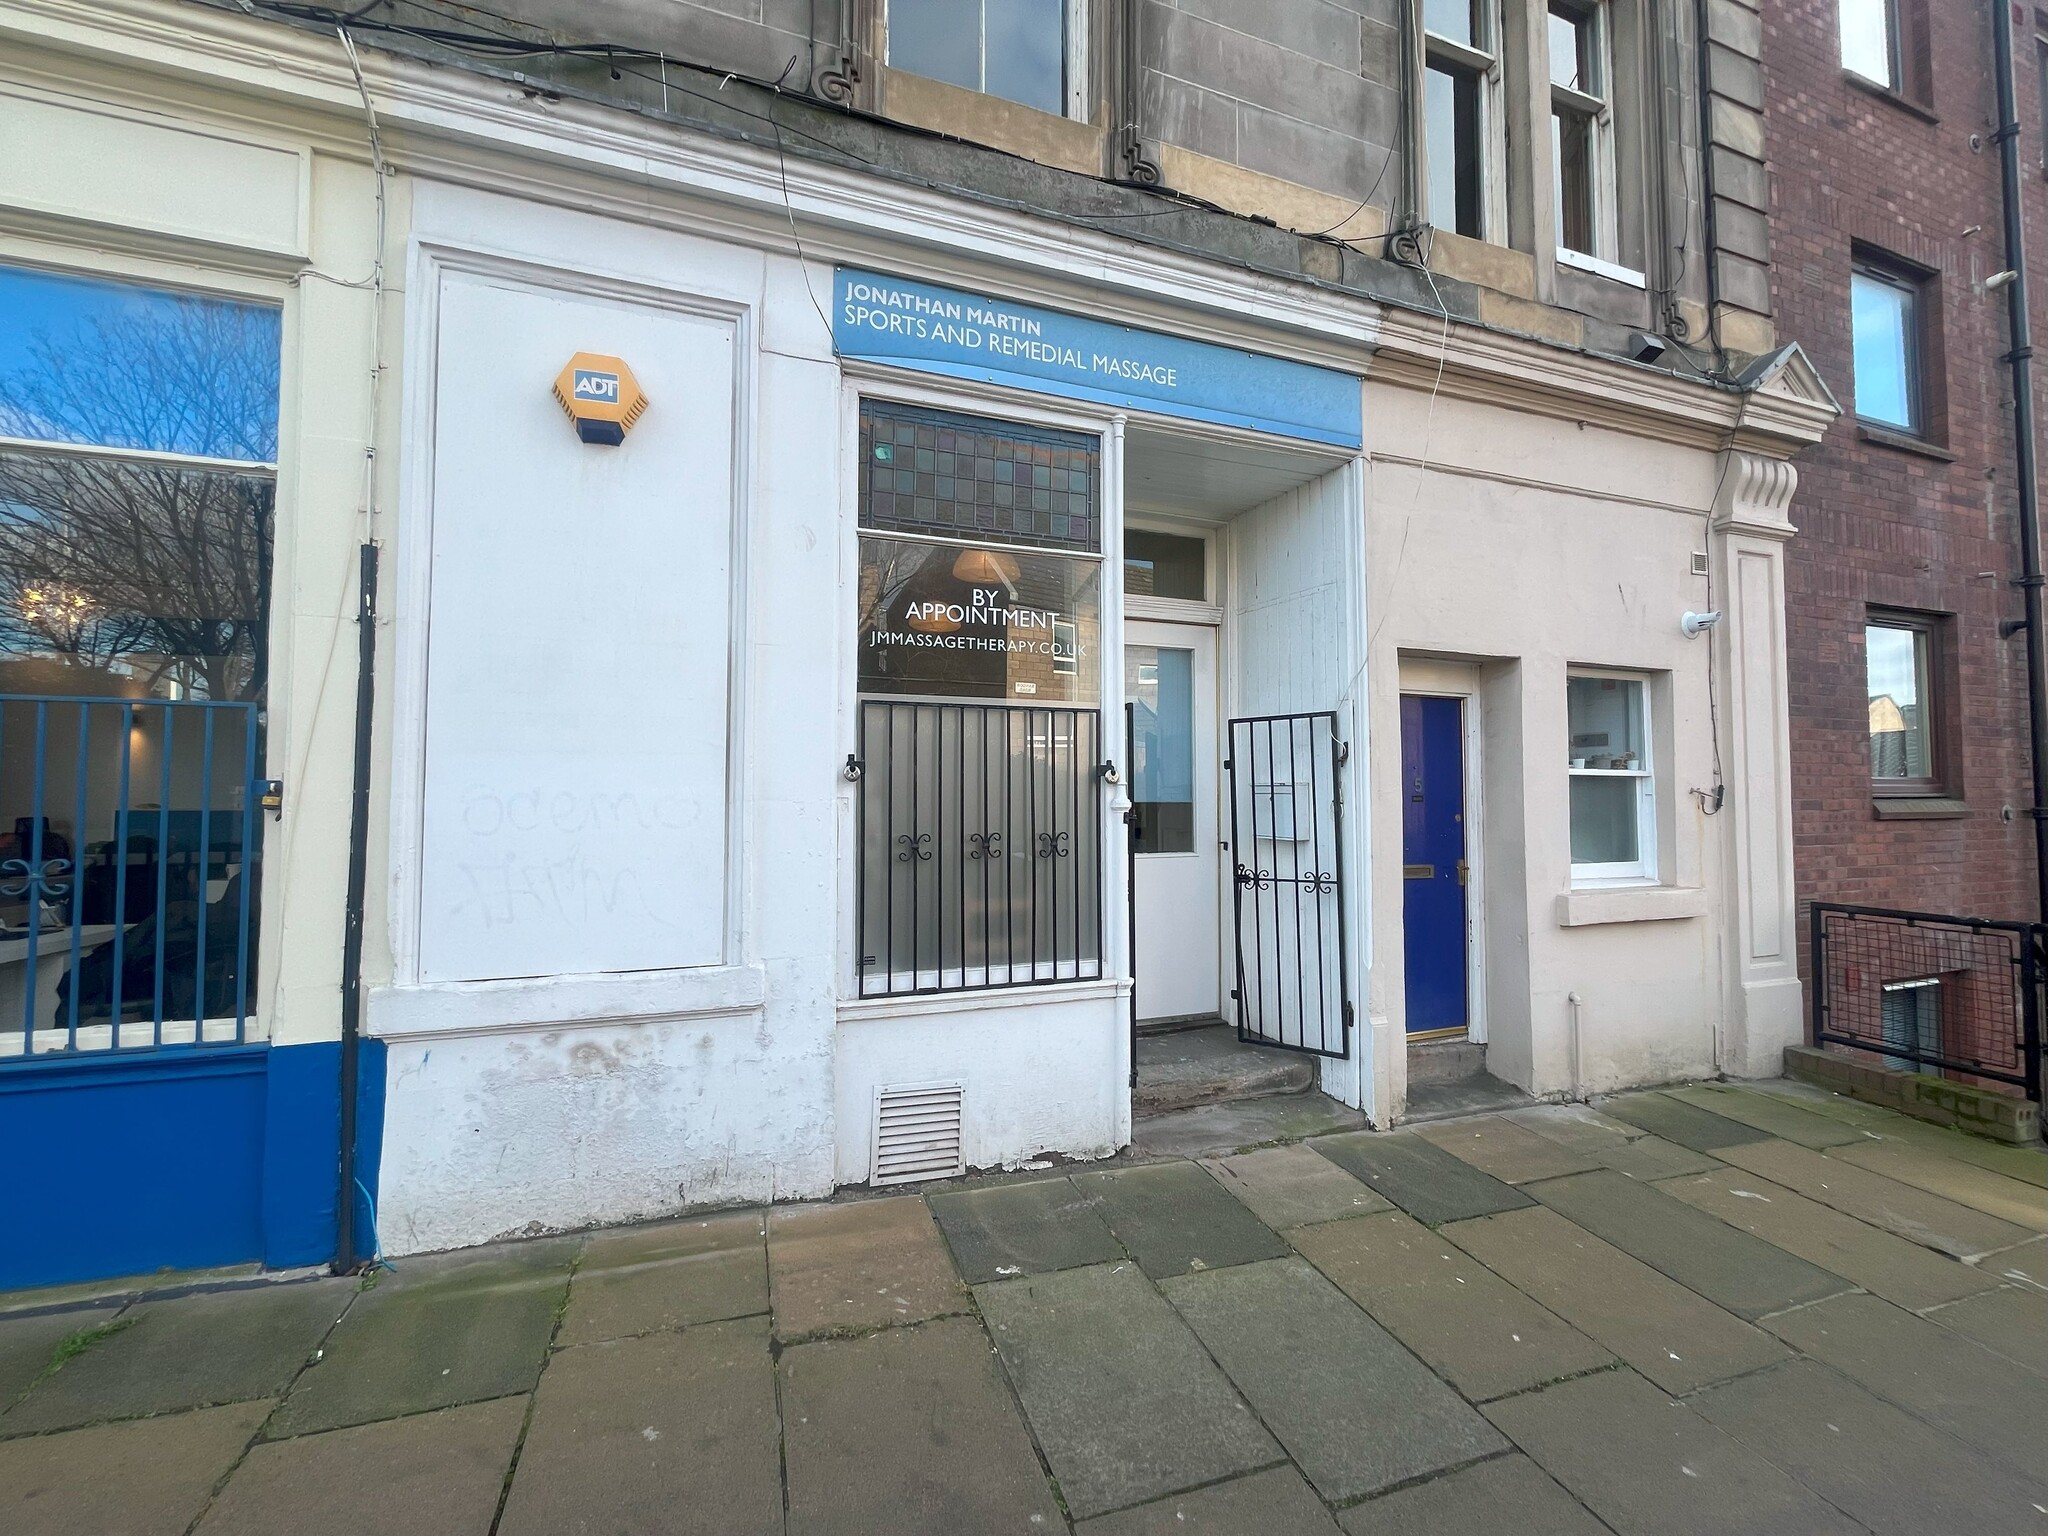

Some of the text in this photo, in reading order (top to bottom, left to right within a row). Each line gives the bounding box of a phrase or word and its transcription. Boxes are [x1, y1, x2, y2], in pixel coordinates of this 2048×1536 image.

[845, 282, 1041, 337] JONATHAN MARTIN
[844, 304, 1177, 387] SPORTS AND REMEDIAL MASSAGE
[575, 376, 618, 396] ADT
[973, 588, 998, 607] BY
[905, 601, 1060, 629] APPOINTMENT
[870, 630, 1087, 657] JMMASSAGETHERAPY.CO.UK
[1414, 777, 1422, 792] 5
